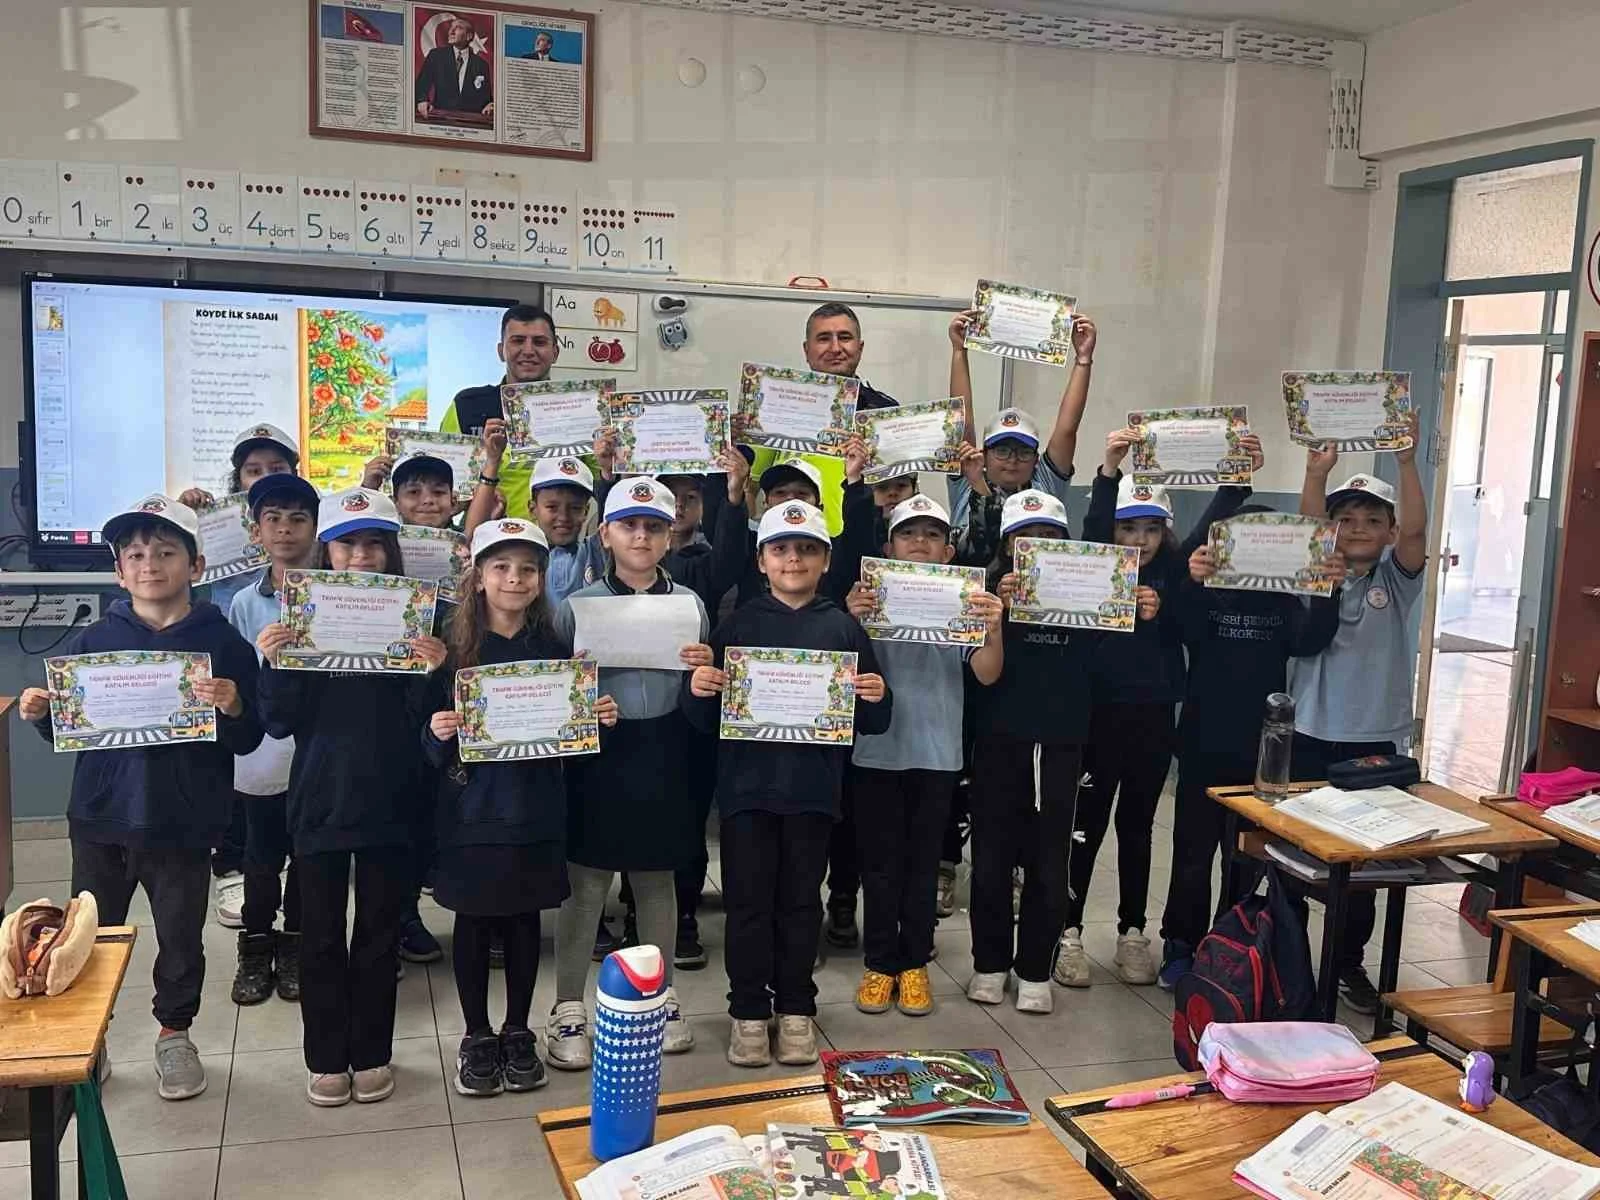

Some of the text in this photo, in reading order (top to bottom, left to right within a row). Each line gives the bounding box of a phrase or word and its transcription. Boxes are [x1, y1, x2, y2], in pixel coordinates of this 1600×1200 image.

[3, 196, 23, 223] 0
[71, 200, 113, 228] 1 bir
[134, 203, 151, 229] 2
[192, 206, 209, 232] 3
[246, 211, 268, 236] 4
[307, 213, 323, 238] 5
[364, 217, 380, 242] 6
[419, 221, 433, 245] 7
[473, 224, 488, 249] 8
[524, 228, 538, 252] 9
[583, 231, 610, 257] 10
[644, 236, 664, 260] 11
[555, 295, 577, 310] Aa
